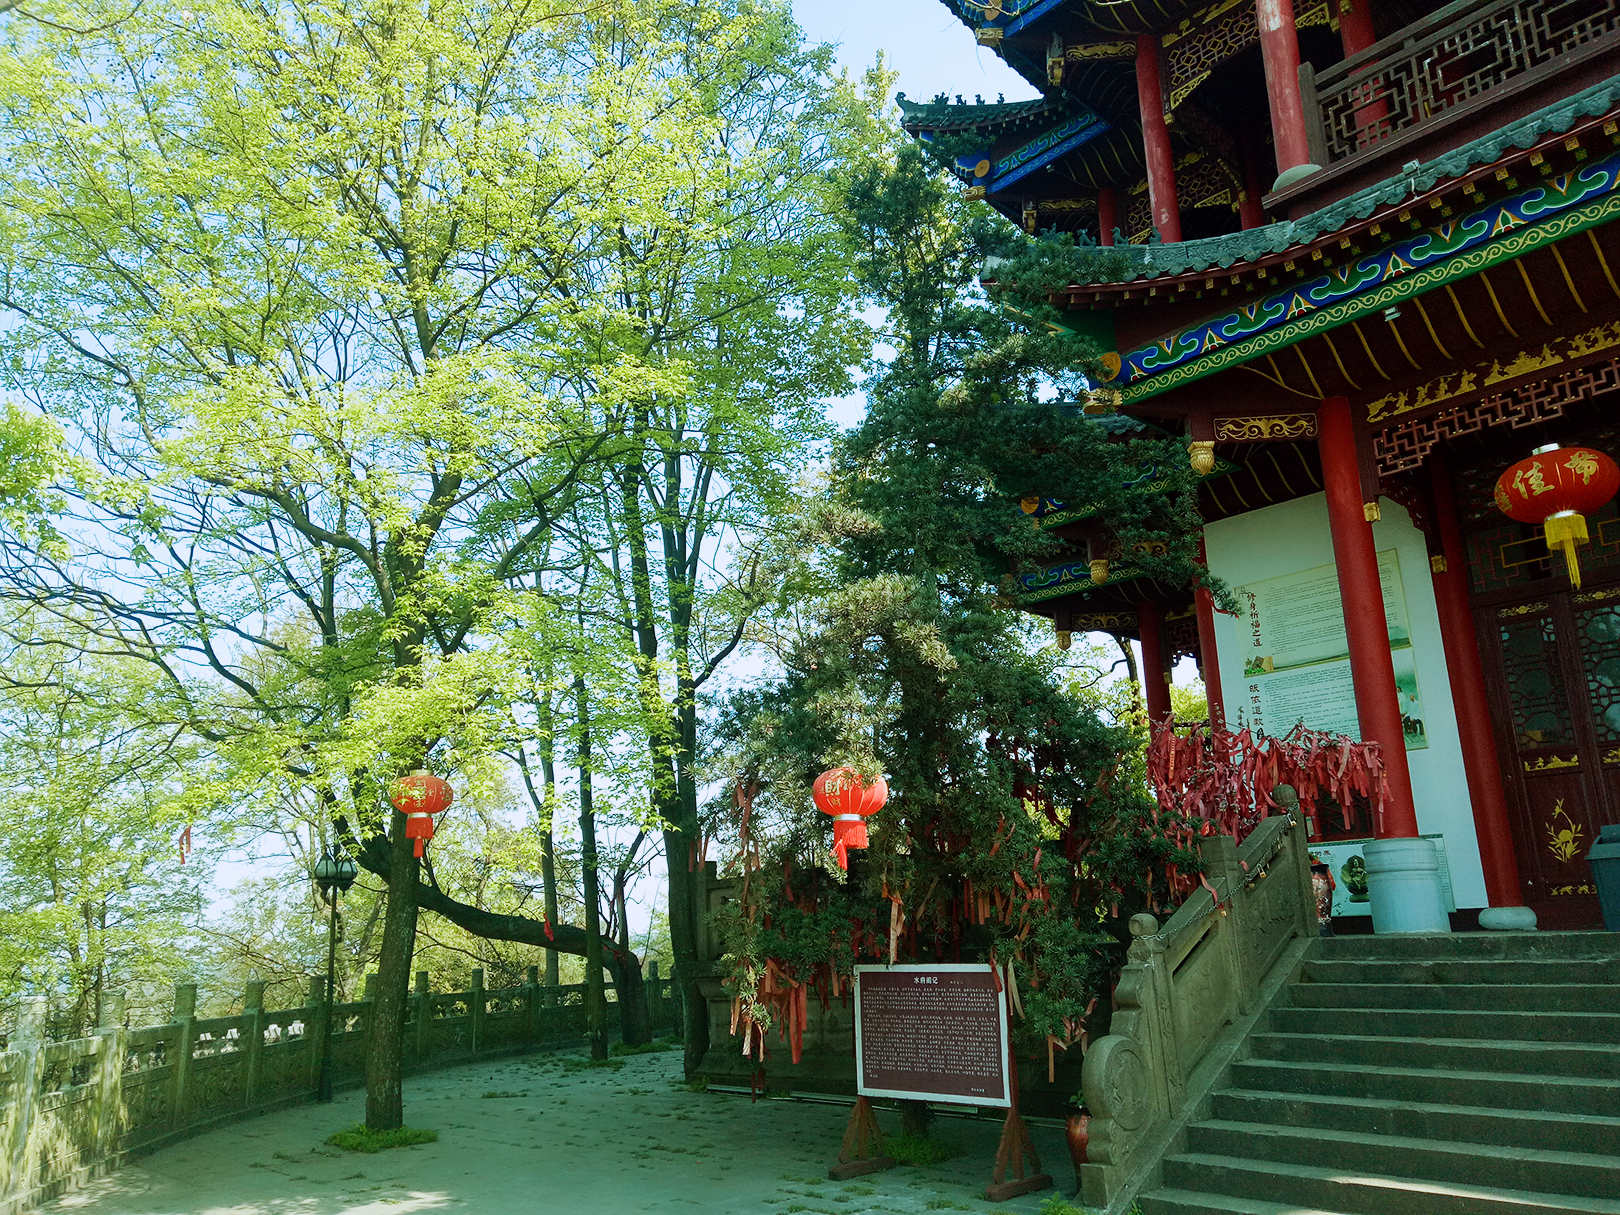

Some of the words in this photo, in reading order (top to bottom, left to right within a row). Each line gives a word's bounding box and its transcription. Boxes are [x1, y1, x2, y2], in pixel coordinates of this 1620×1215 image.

[1247, 592, 1263, 647] 修身祈福之道
